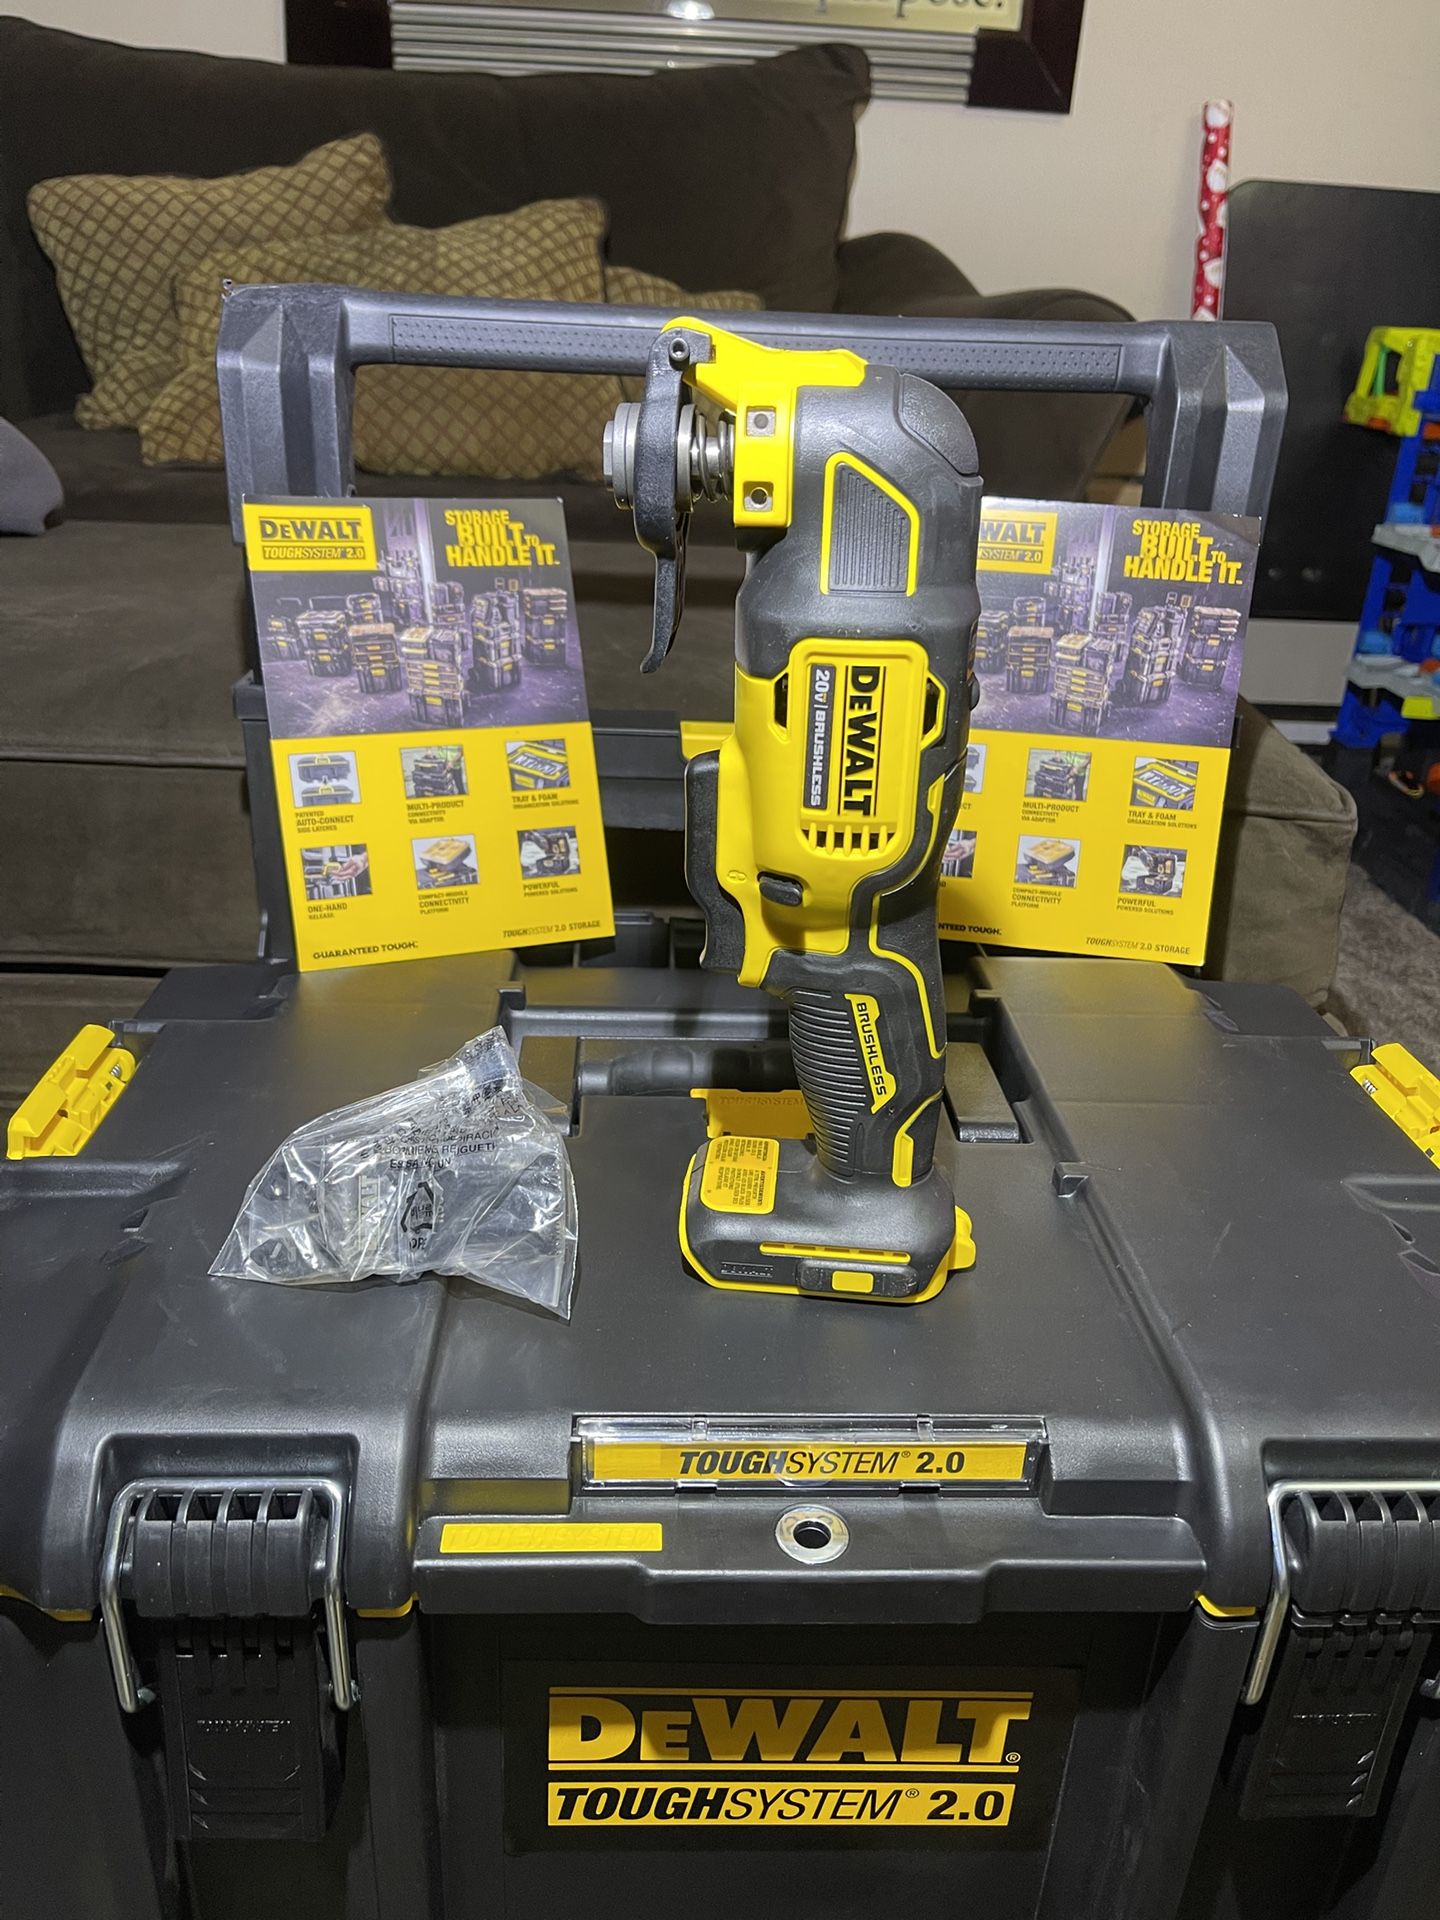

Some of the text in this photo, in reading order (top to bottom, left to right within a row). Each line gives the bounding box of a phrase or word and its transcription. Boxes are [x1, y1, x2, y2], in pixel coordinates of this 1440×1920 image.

[445, 509, 510, 525] STORAGE
[260, 519, 361, 539] DEWALT
[457, 522, 524, 546] BUILT
[980, 521, 1046, 544] WALT
[1132, 519, 1201, 538] STORAGE
[524, 534, 540, 547] TO
[347, 548, 363, 558] 2.0
[1140, 534, 1213, 561] BUILT
[445, 544, 532, 567] HANDLE
[980, 549, 1042, 562] SYSTEM 2.0
[1211, 551, 1226, 563] TO
[1123, 555, 1213, 583] HANDLE
[844, 666, 880, 816] DEWALT
[810, 710, 826, 806] BRUSHLESS
[407, 800, 464, 811] MULTI-PRODUCT
[1022, 801, 1079, 812] MULTI-PRODUCT
[296, 815, 354, 827] AUTO-CONNECT
[1128, 810, 1146, 818] TRAY
[1155, 812, 1176, 820] FOAM
[523, 881, 560, 890] POWERFUL
[419, 897, 469, 909] CONNECTIVITY
[1012, 894, 1061, 905] CONNECTIVITY
[1118, 897, 1156, 907] POWERFUL
[308, 903, 347, 913] ONE-HAND
[1116, 904, 1174, 915] POWERED SOLUTIONS
[555, 923, 567, 932] 2.0
[569, 920, 600, 931] STORAGE
[938, 923, 966, 932] NTEED
[1085, 937, 1191, 954] TOUGHSYSTEM 2.0 STORAGE
[313, 946, 379, 959] GUARANTEED
[857, 1003, 887, 1096] BRUSHLESS
[916, 1451, 965, 1473] 2.0
[927, 1790, 1005, 1820] 2.0
